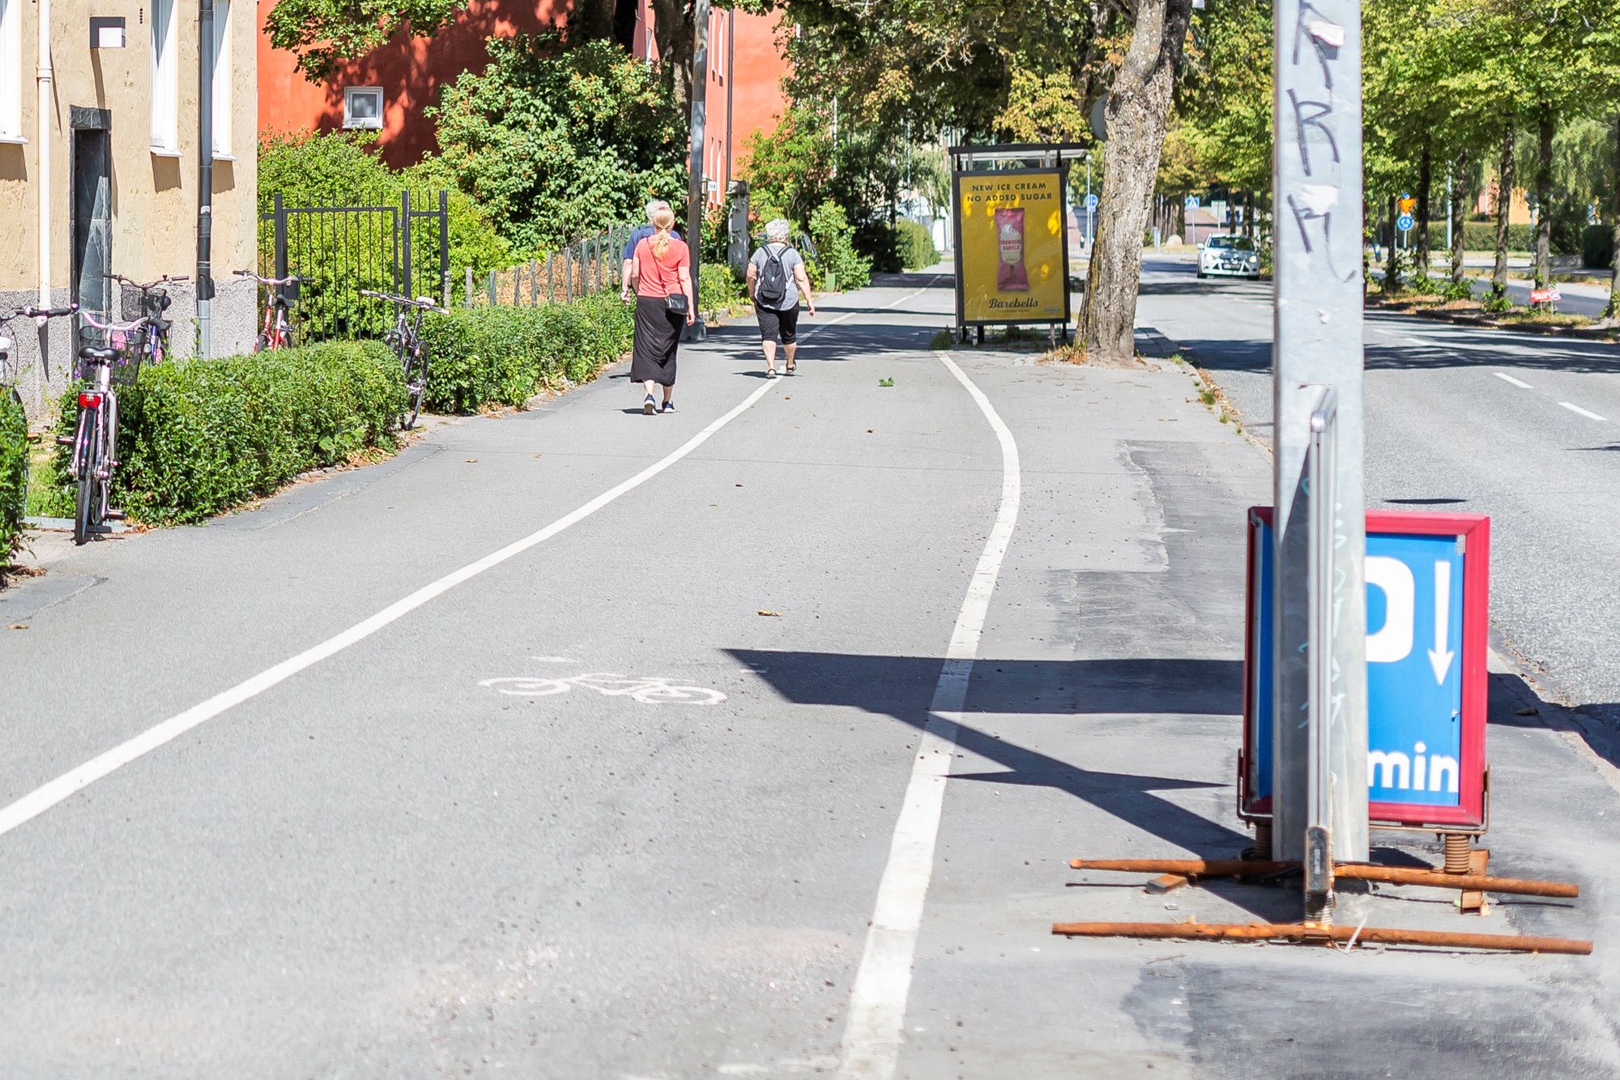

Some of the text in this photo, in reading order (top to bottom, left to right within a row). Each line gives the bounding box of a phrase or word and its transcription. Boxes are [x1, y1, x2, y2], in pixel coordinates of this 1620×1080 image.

[1014, 182, 1047, 190] CREAM
[985, 194, 1017, 202] ADDED
[1020, 192, 1052, 200] SUGAR
[988, 296, 1039, 309] Barebells
[1367, 741, 1459, 793] min
